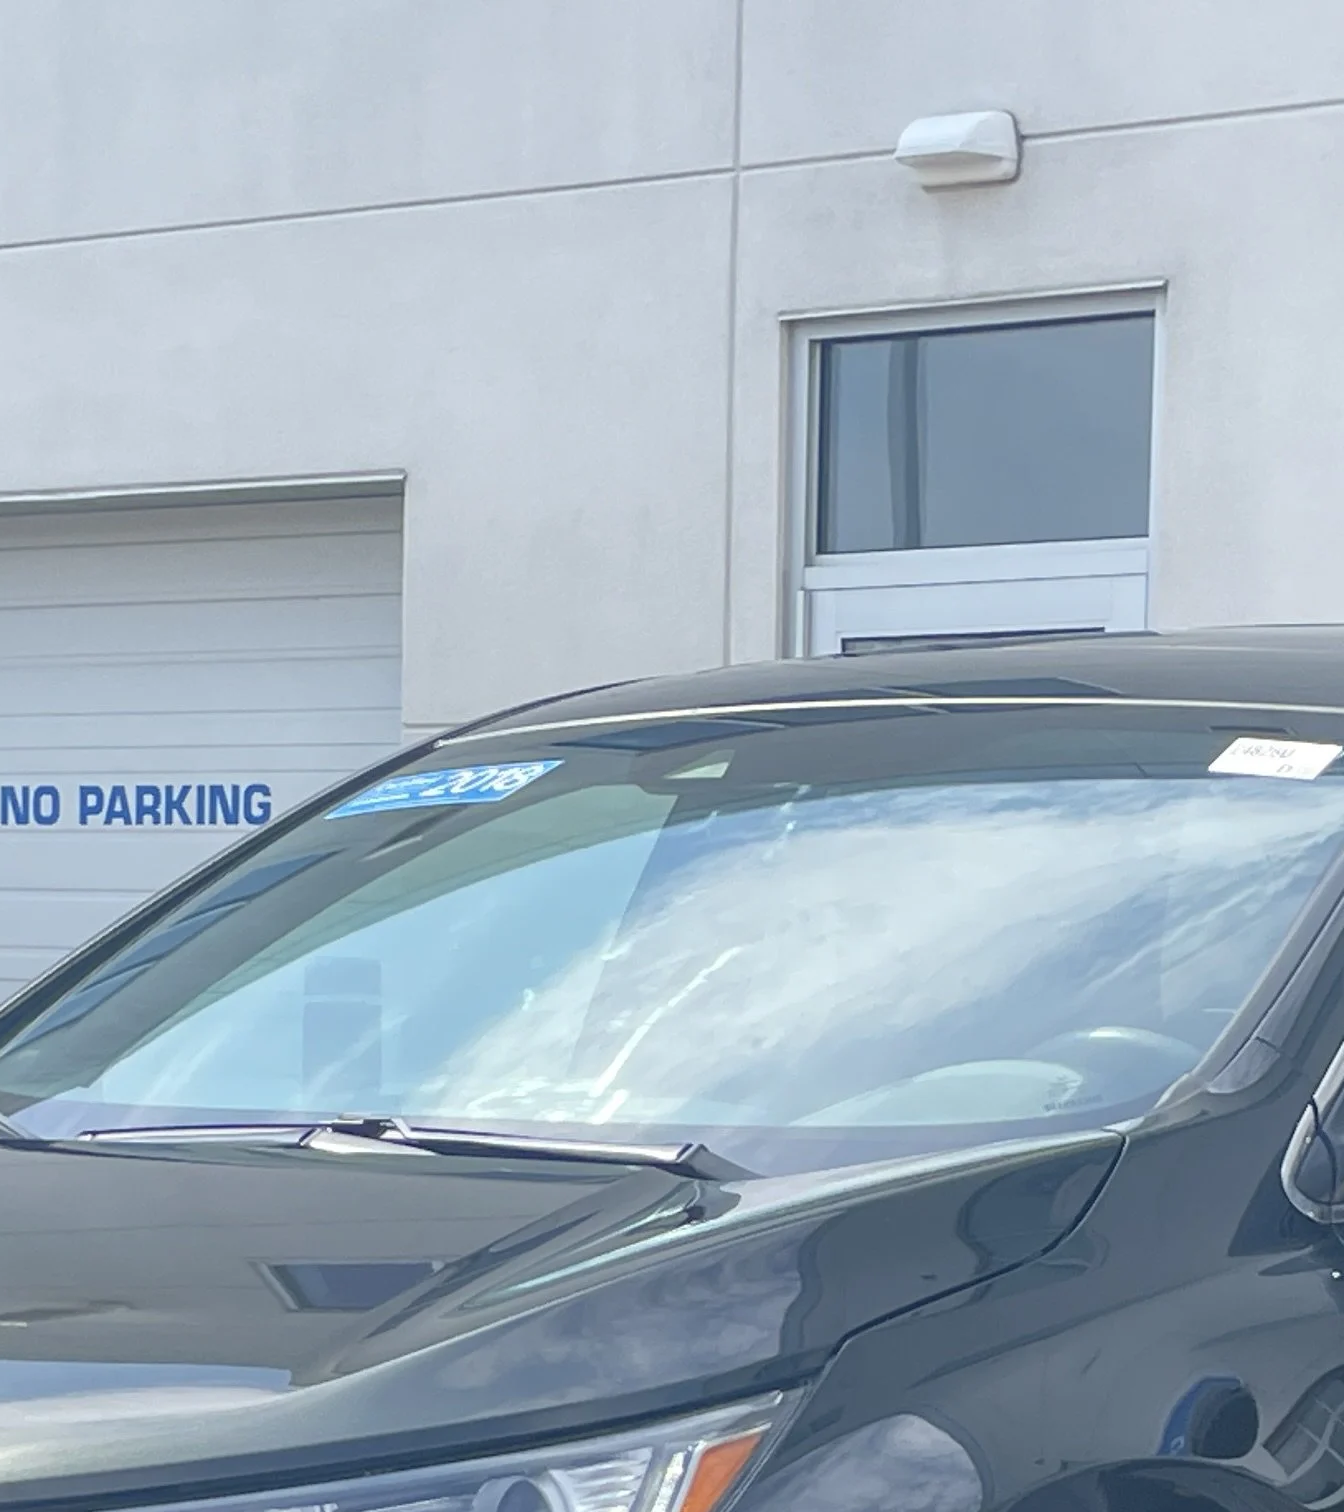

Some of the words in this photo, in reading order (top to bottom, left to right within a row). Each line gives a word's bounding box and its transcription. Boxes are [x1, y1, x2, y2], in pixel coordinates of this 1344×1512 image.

[419, 763, 545, 798] 2018
[0, 784, 61, 826] NO
[78, 783, 272, 826] PARKING
